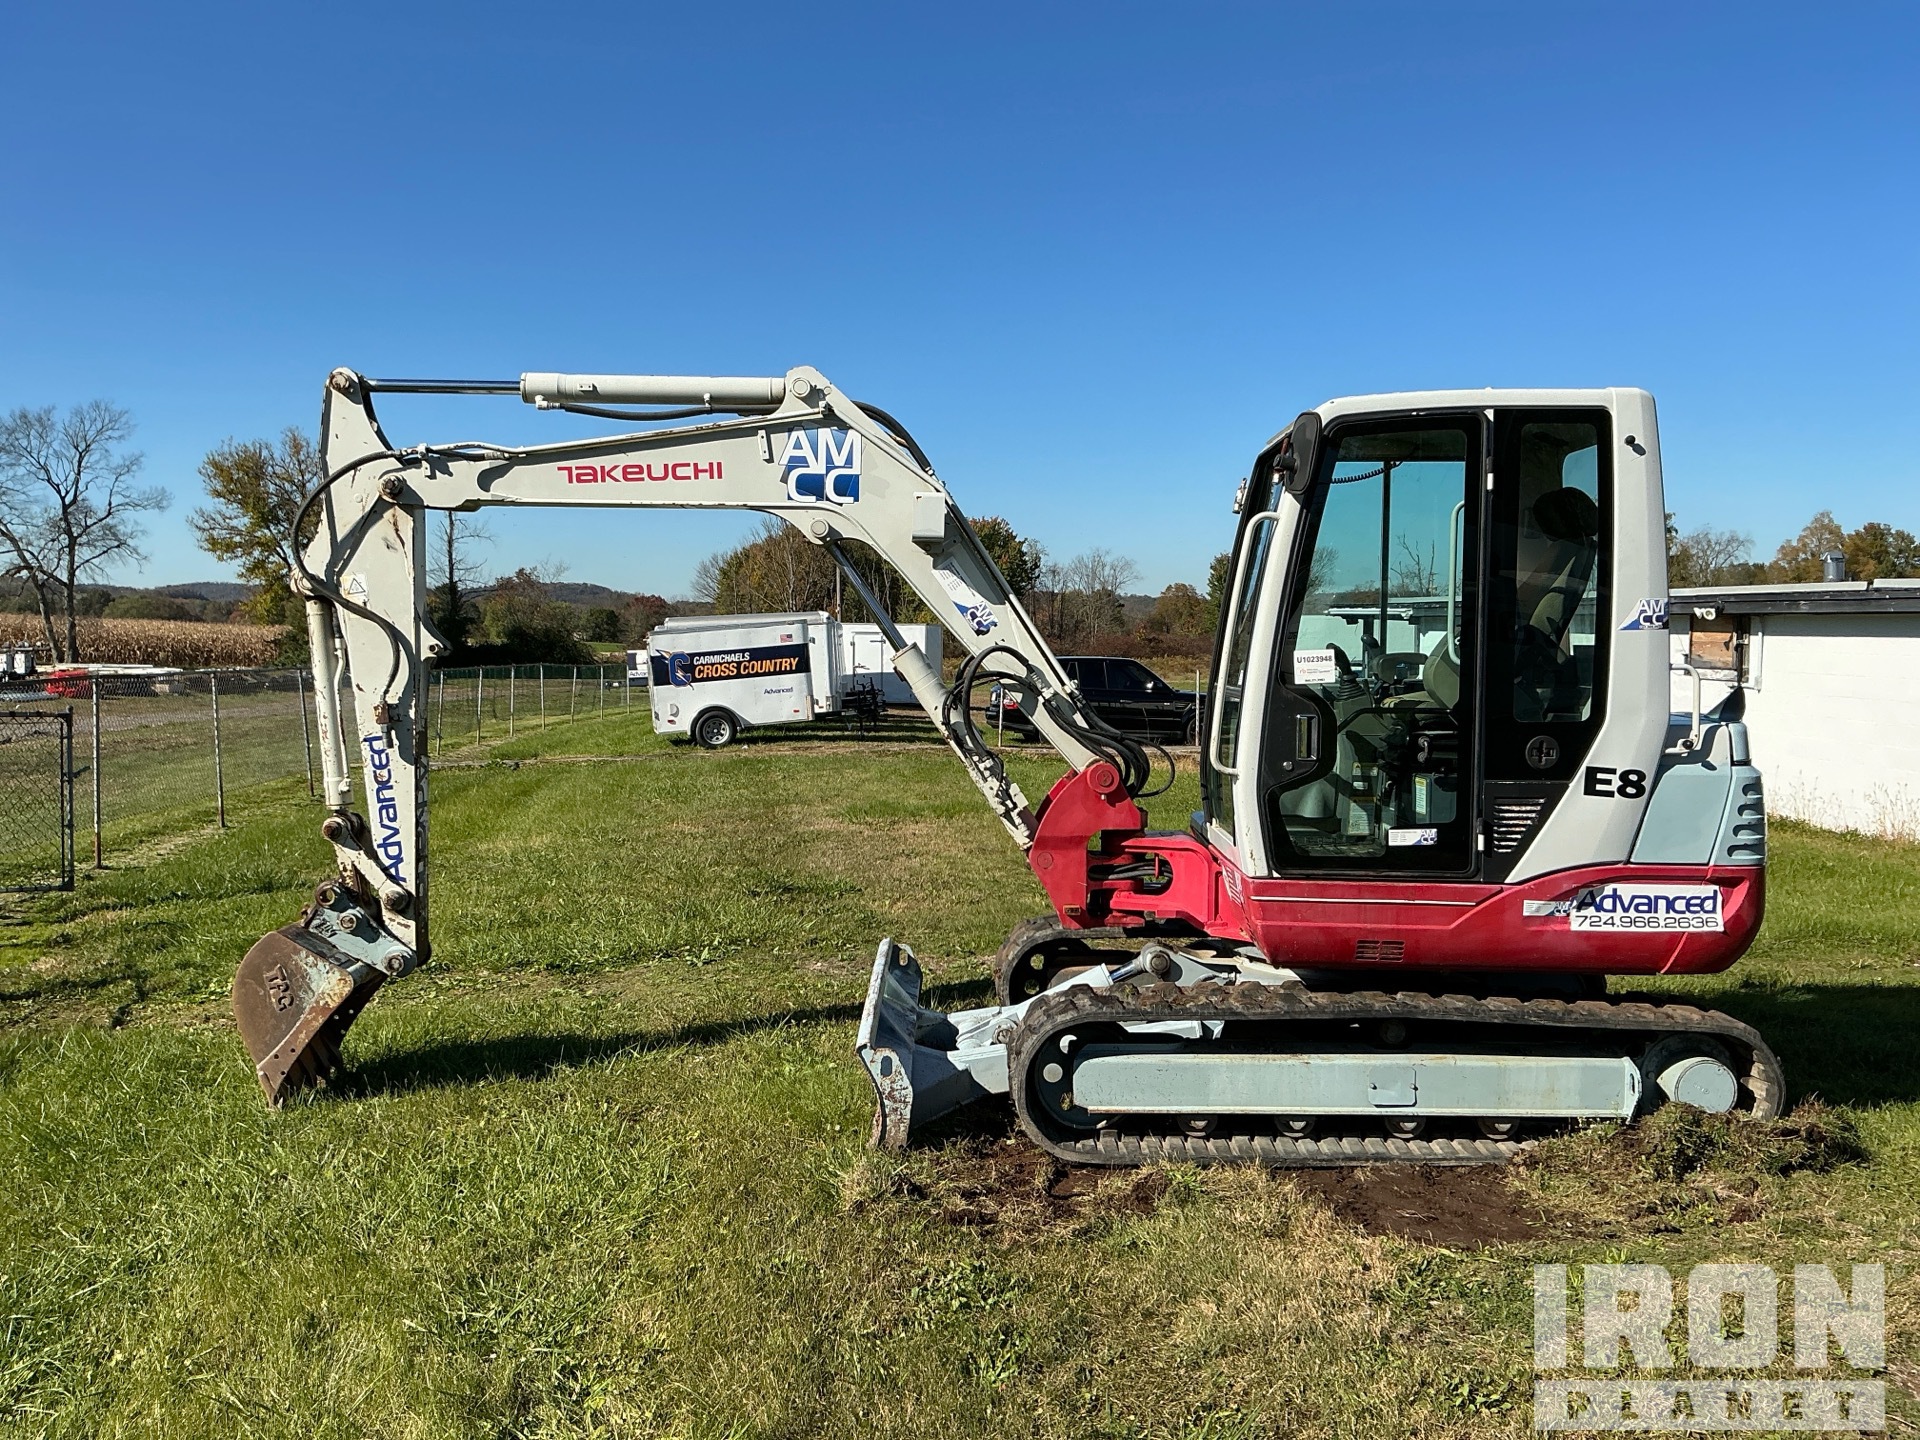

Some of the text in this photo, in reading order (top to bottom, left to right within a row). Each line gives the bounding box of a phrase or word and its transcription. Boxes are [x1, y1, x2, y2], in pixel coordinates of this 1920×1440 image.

[779, 427, 862, 475] AM
[787, 467, 855, 504] CC
[1639, 599, 1665, 615] AM
[693, 652, 750, 666] CARMICHAELS
[694, 657, 799, 679] CROSS COUNTRY
[1296, 655, 1333, 664] U1023948
[1582, 765, 1647, 799] E8
[362, 734, 408, 884] Advanced
[1574, 887, 1719, 915] Advanced
[1575, 915, 1719, 929] 724.966.2636
